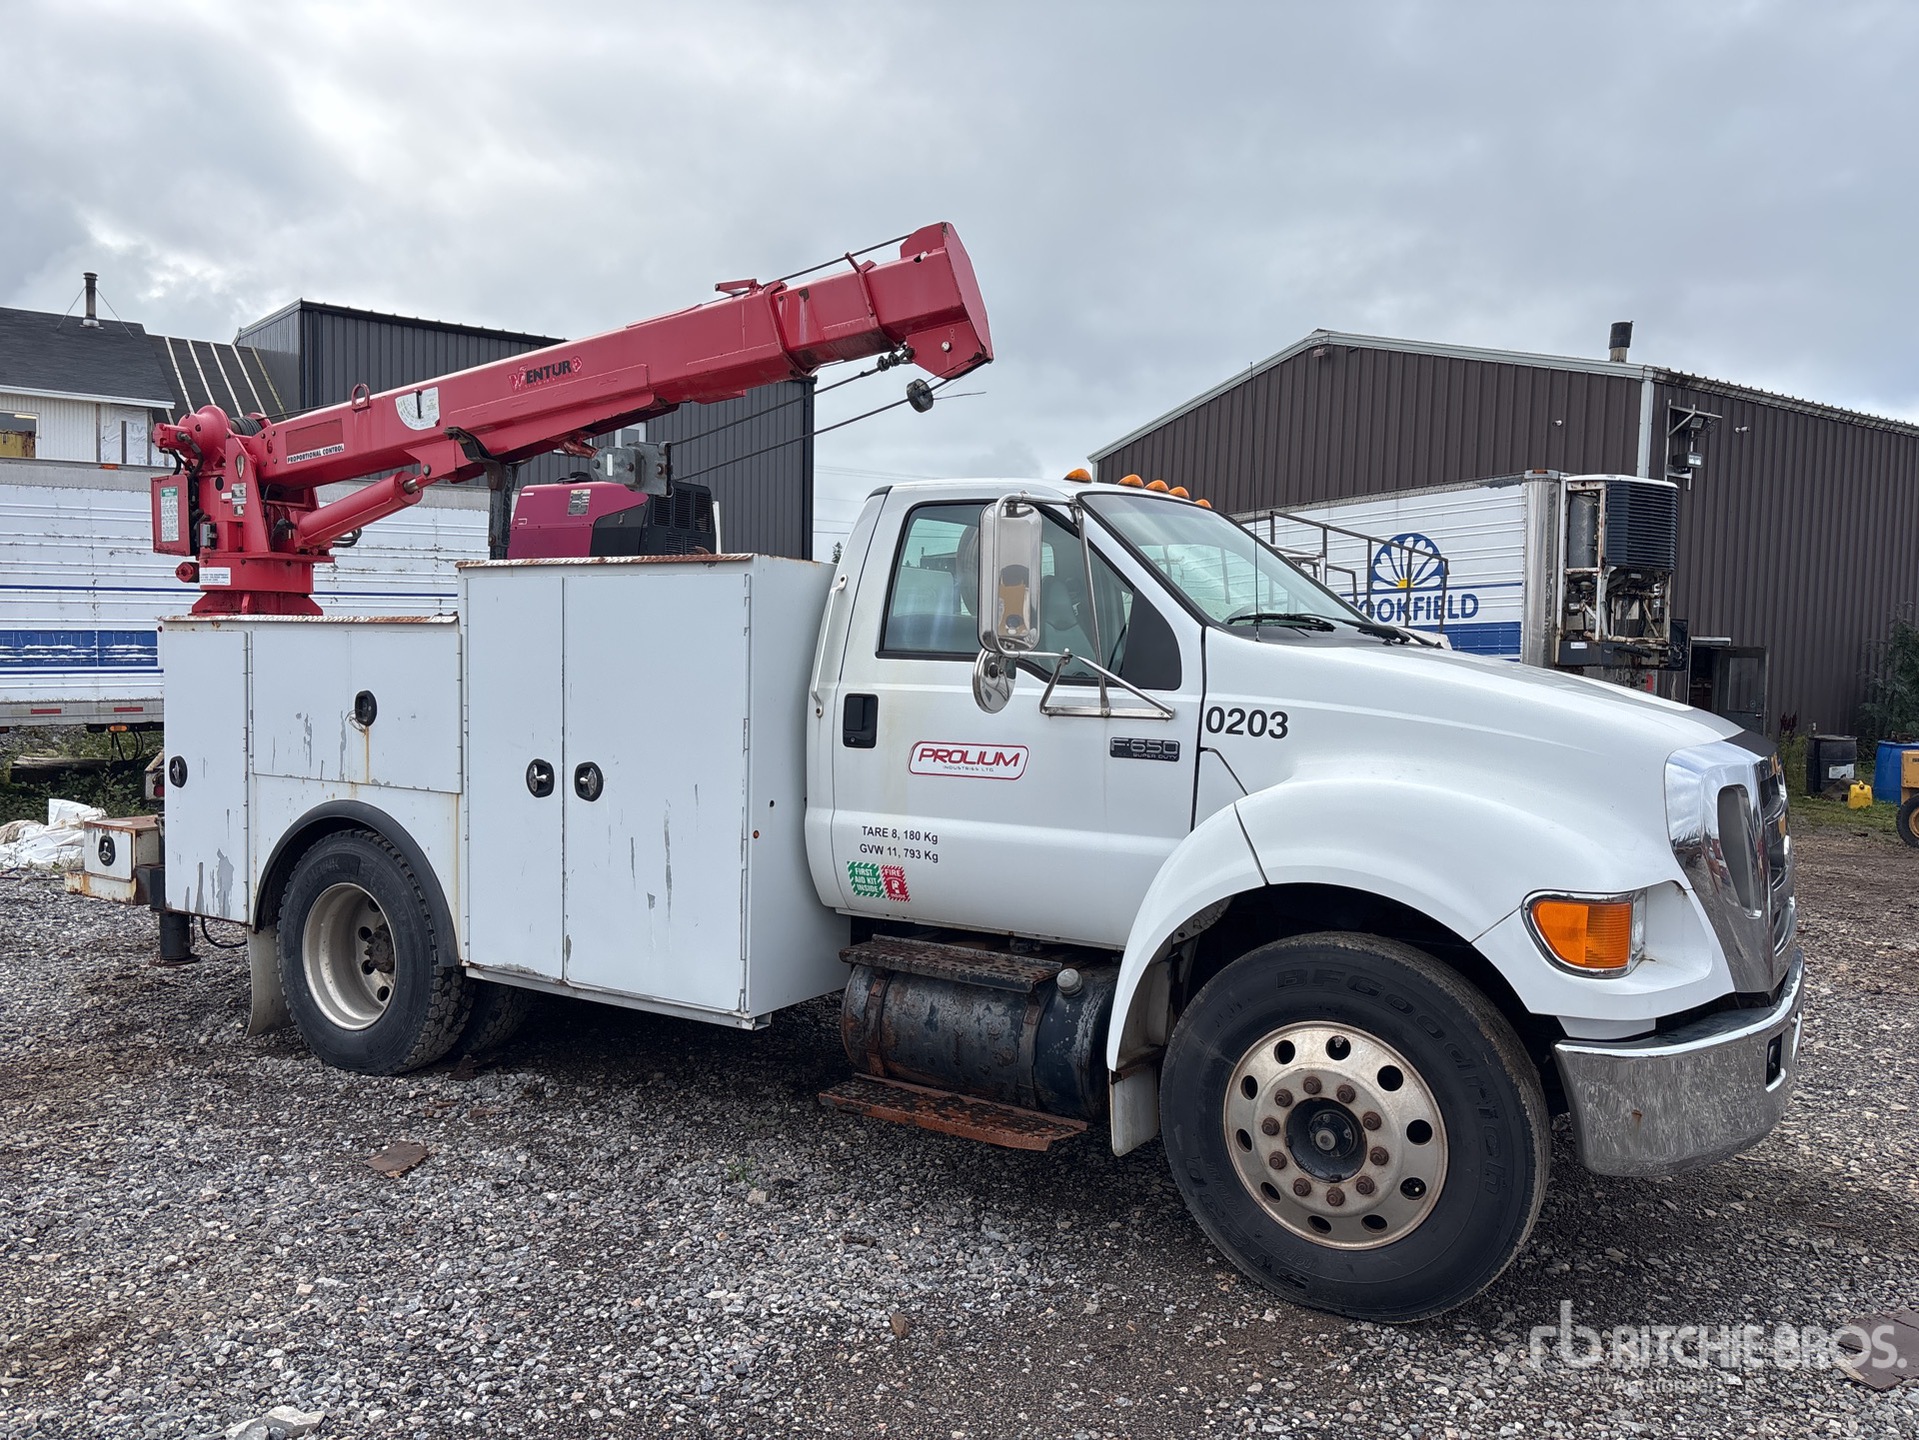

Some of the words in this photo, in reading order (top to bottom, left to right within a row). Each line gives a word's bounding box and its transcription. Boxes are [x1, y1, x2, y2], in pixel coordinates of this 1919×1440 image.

[287, 449, 322, 463] PROPORTIONAL
[322, 444, 344, 456] CONTROL
[1205, 706, 1289, 739] 0203
[918, 747, 1021, 767] PROLIUM
[862, 825, 889, 838] TARE
[903, 830, 921, 841] 180
[924, 831, 938, 845] Kg
[859, 843, 884, 855] GVW
[903, 848, 921, 859] 793
[924, 850, 939, 863] Kg
[855, 867, 873, 876] FIRST
[855, 876, 866, 884] AID
[867, 877, 877, 885] KIT
[884, 868, 903, 877] FIRE
[856, 883, 879, 892] INSIDE
